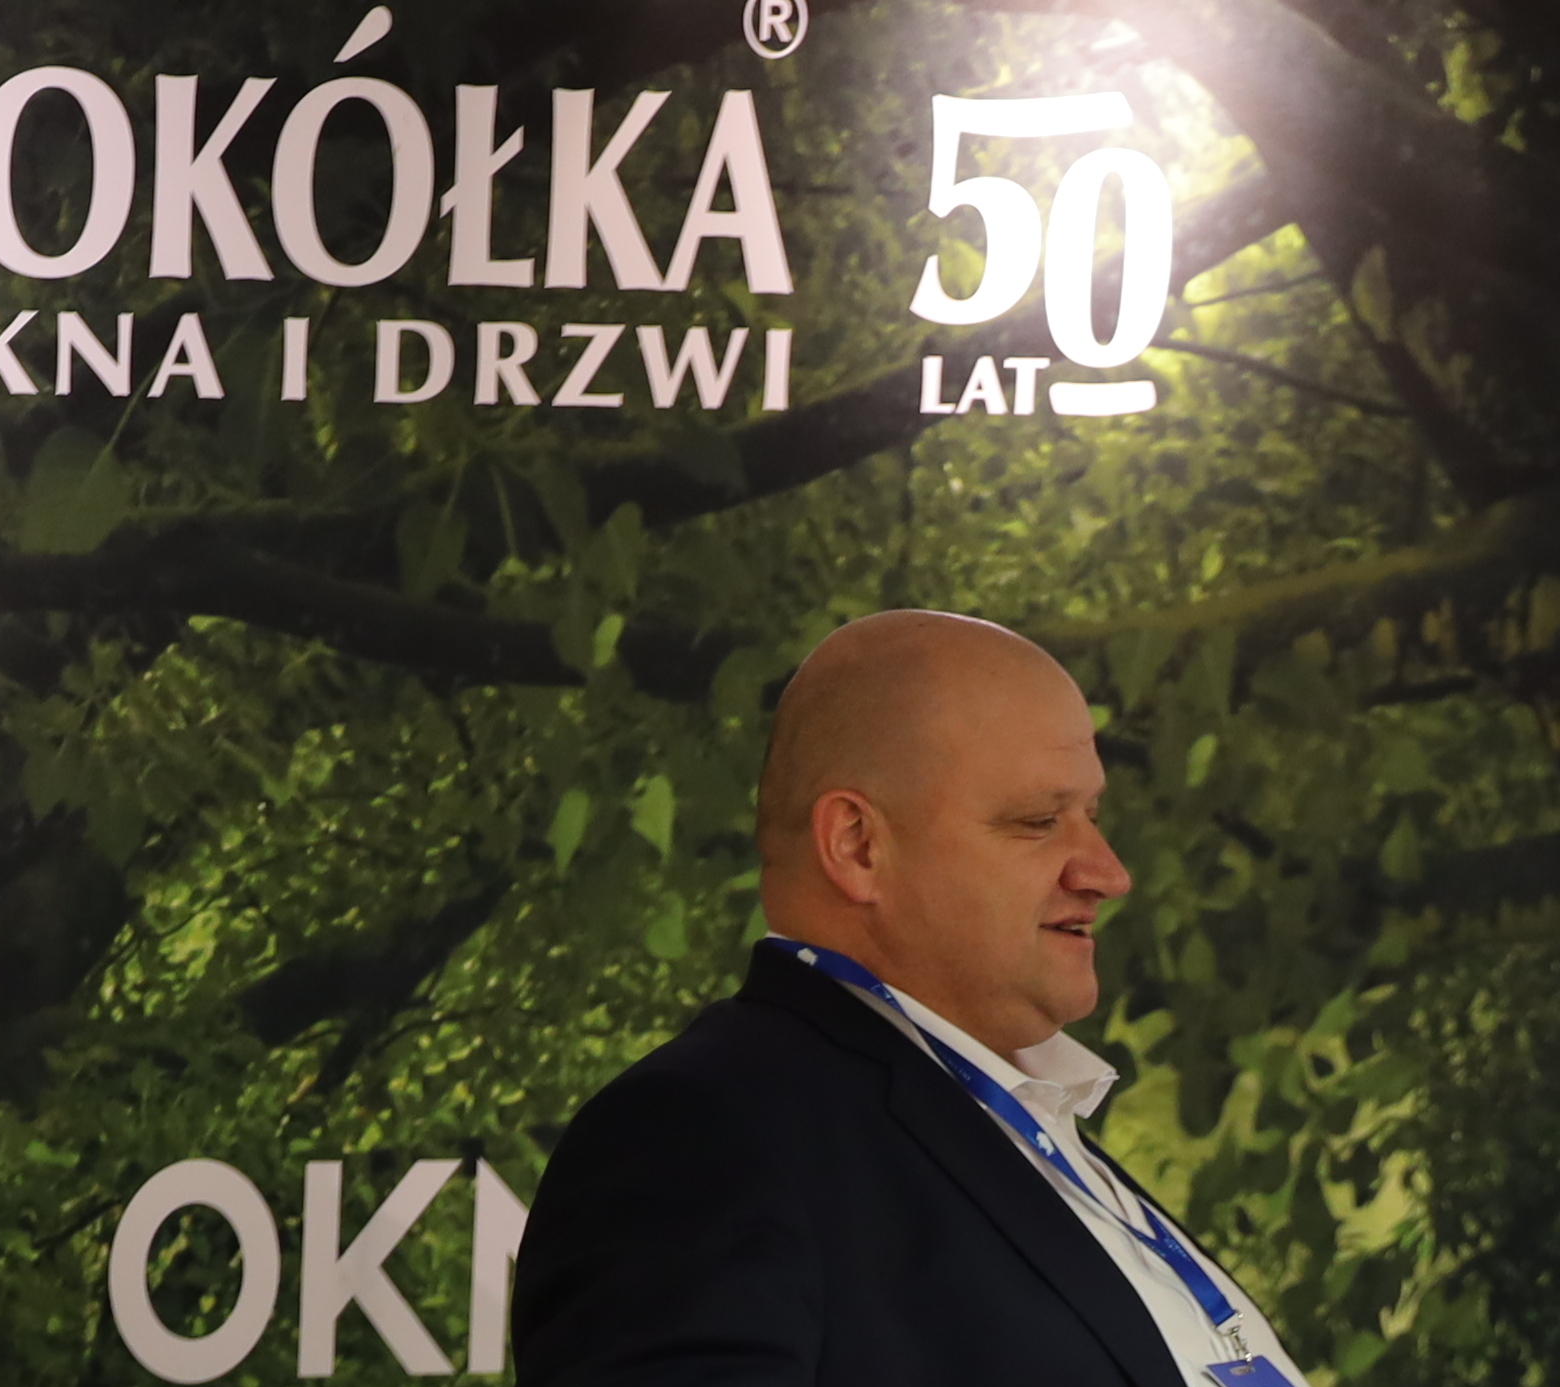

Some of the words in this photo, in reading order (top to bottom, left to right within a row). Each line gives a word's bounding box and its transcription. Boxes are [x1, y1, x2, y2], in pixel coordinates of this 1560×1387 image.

[910, 94, 1174, 370] 50
[281, 318, 306, 403] I
[374, 318, 792, 412] DRZWI
[922, 356, 1052, 415] LAT
